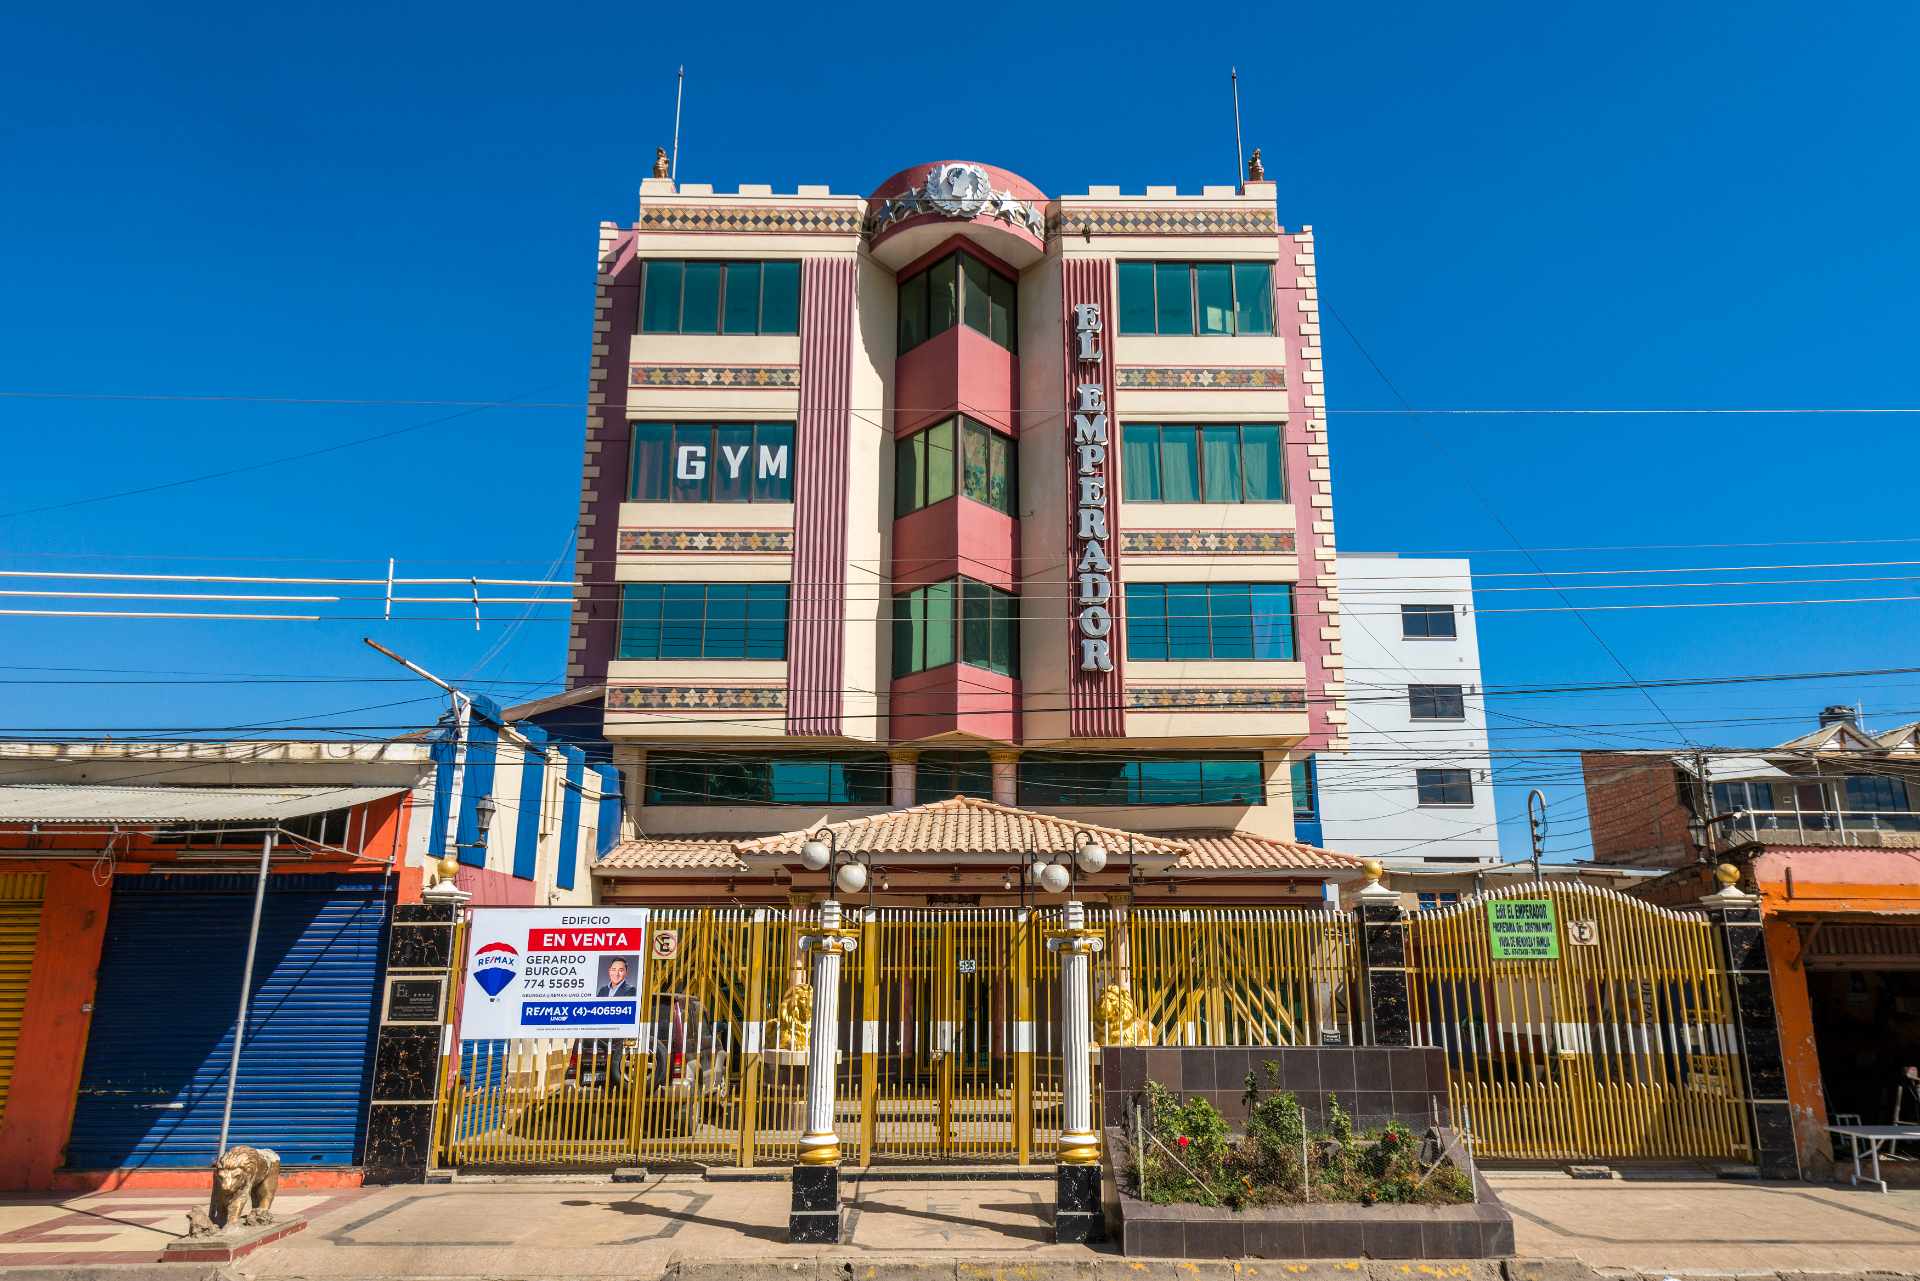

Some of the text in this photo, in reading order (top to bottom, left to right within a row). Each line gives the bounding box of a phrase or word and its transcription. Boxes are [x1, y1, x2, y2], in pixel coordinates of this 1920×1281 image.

[676, 445, 788, 480] GYM
[1074, 303, 1114, 672] EL EMPERADOR
[1515, 903, 1547, 919] EMPERADOR
[562, 916, 610, 925] EDIFICIO
[543, 933, 628, 947] EN VENTA
[478, 957, 515, 967] RE/MAX
[526, 955, 586, 965] GERARDO
[525, 967, 577, 976] BURGOA
[523, 978, 585, 989] 774 55695
[525, 1006, 632, 1017] RE/MAX (4)-4065941
